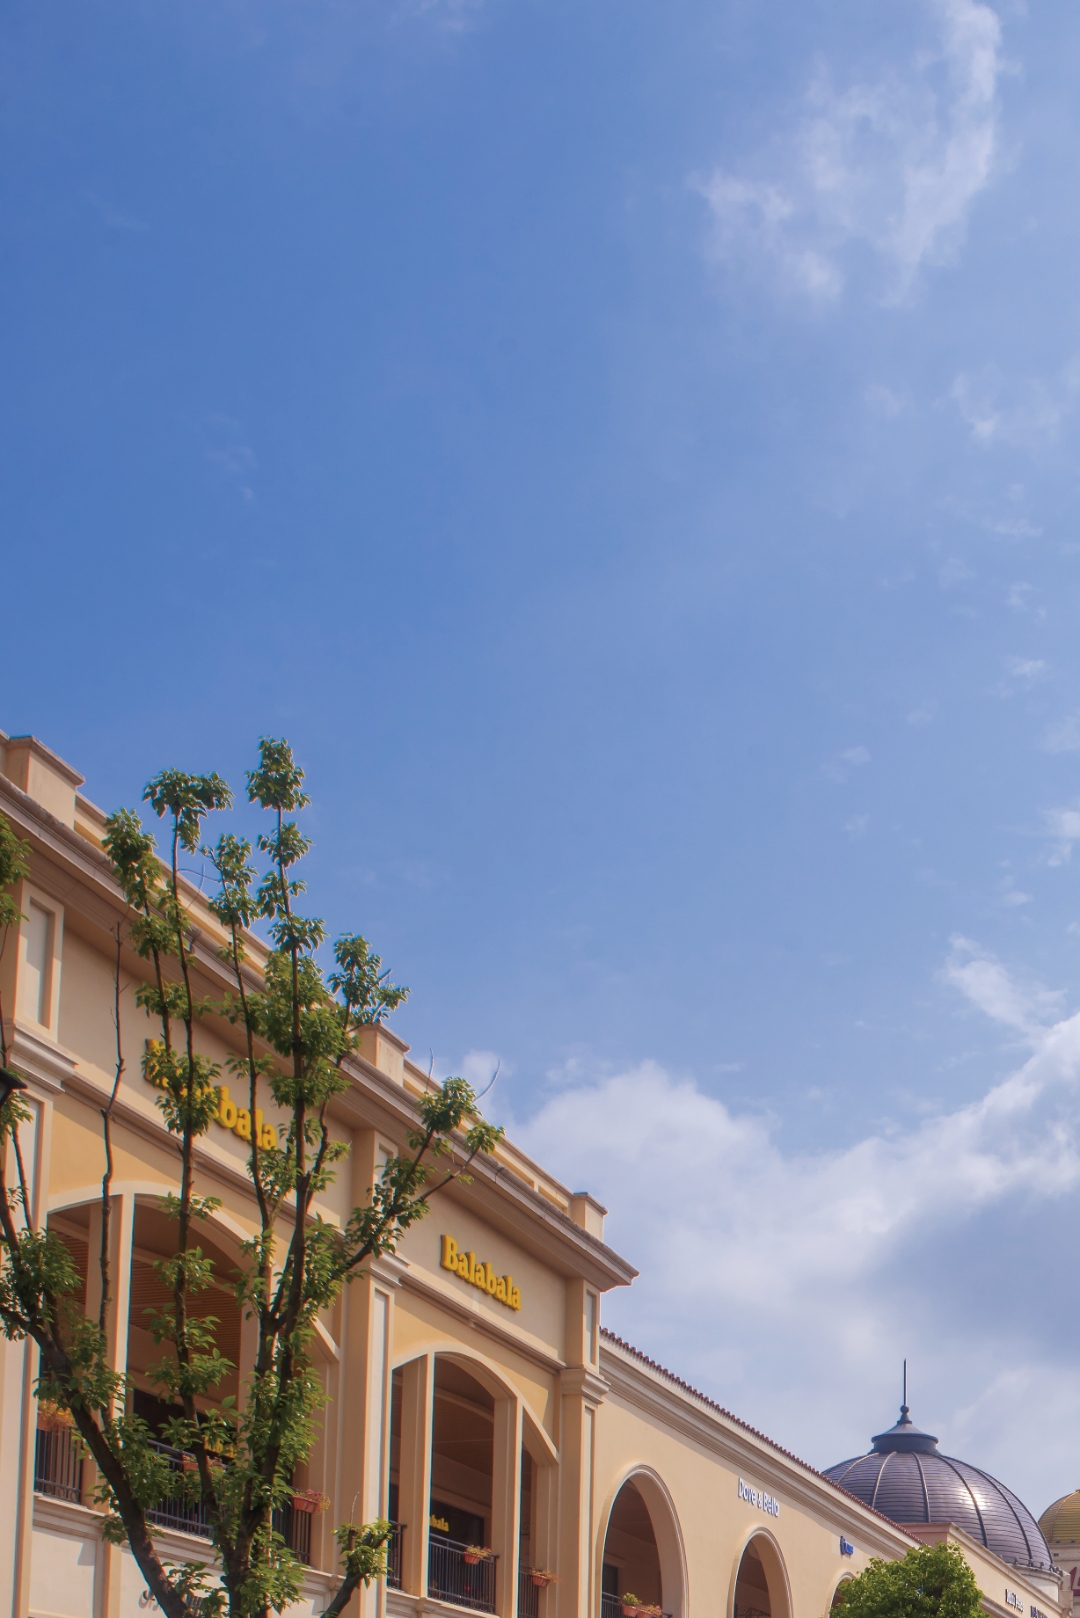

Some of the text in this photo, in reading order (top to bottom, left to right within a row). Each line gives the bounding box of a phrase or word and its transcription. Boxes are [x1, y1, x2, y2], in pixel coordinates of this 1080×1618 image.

[440, 1234, 522, 1311] Balabala
[738, 1477, 756, 1506] Dove
[763, 1491, 780, 1518] Bella
